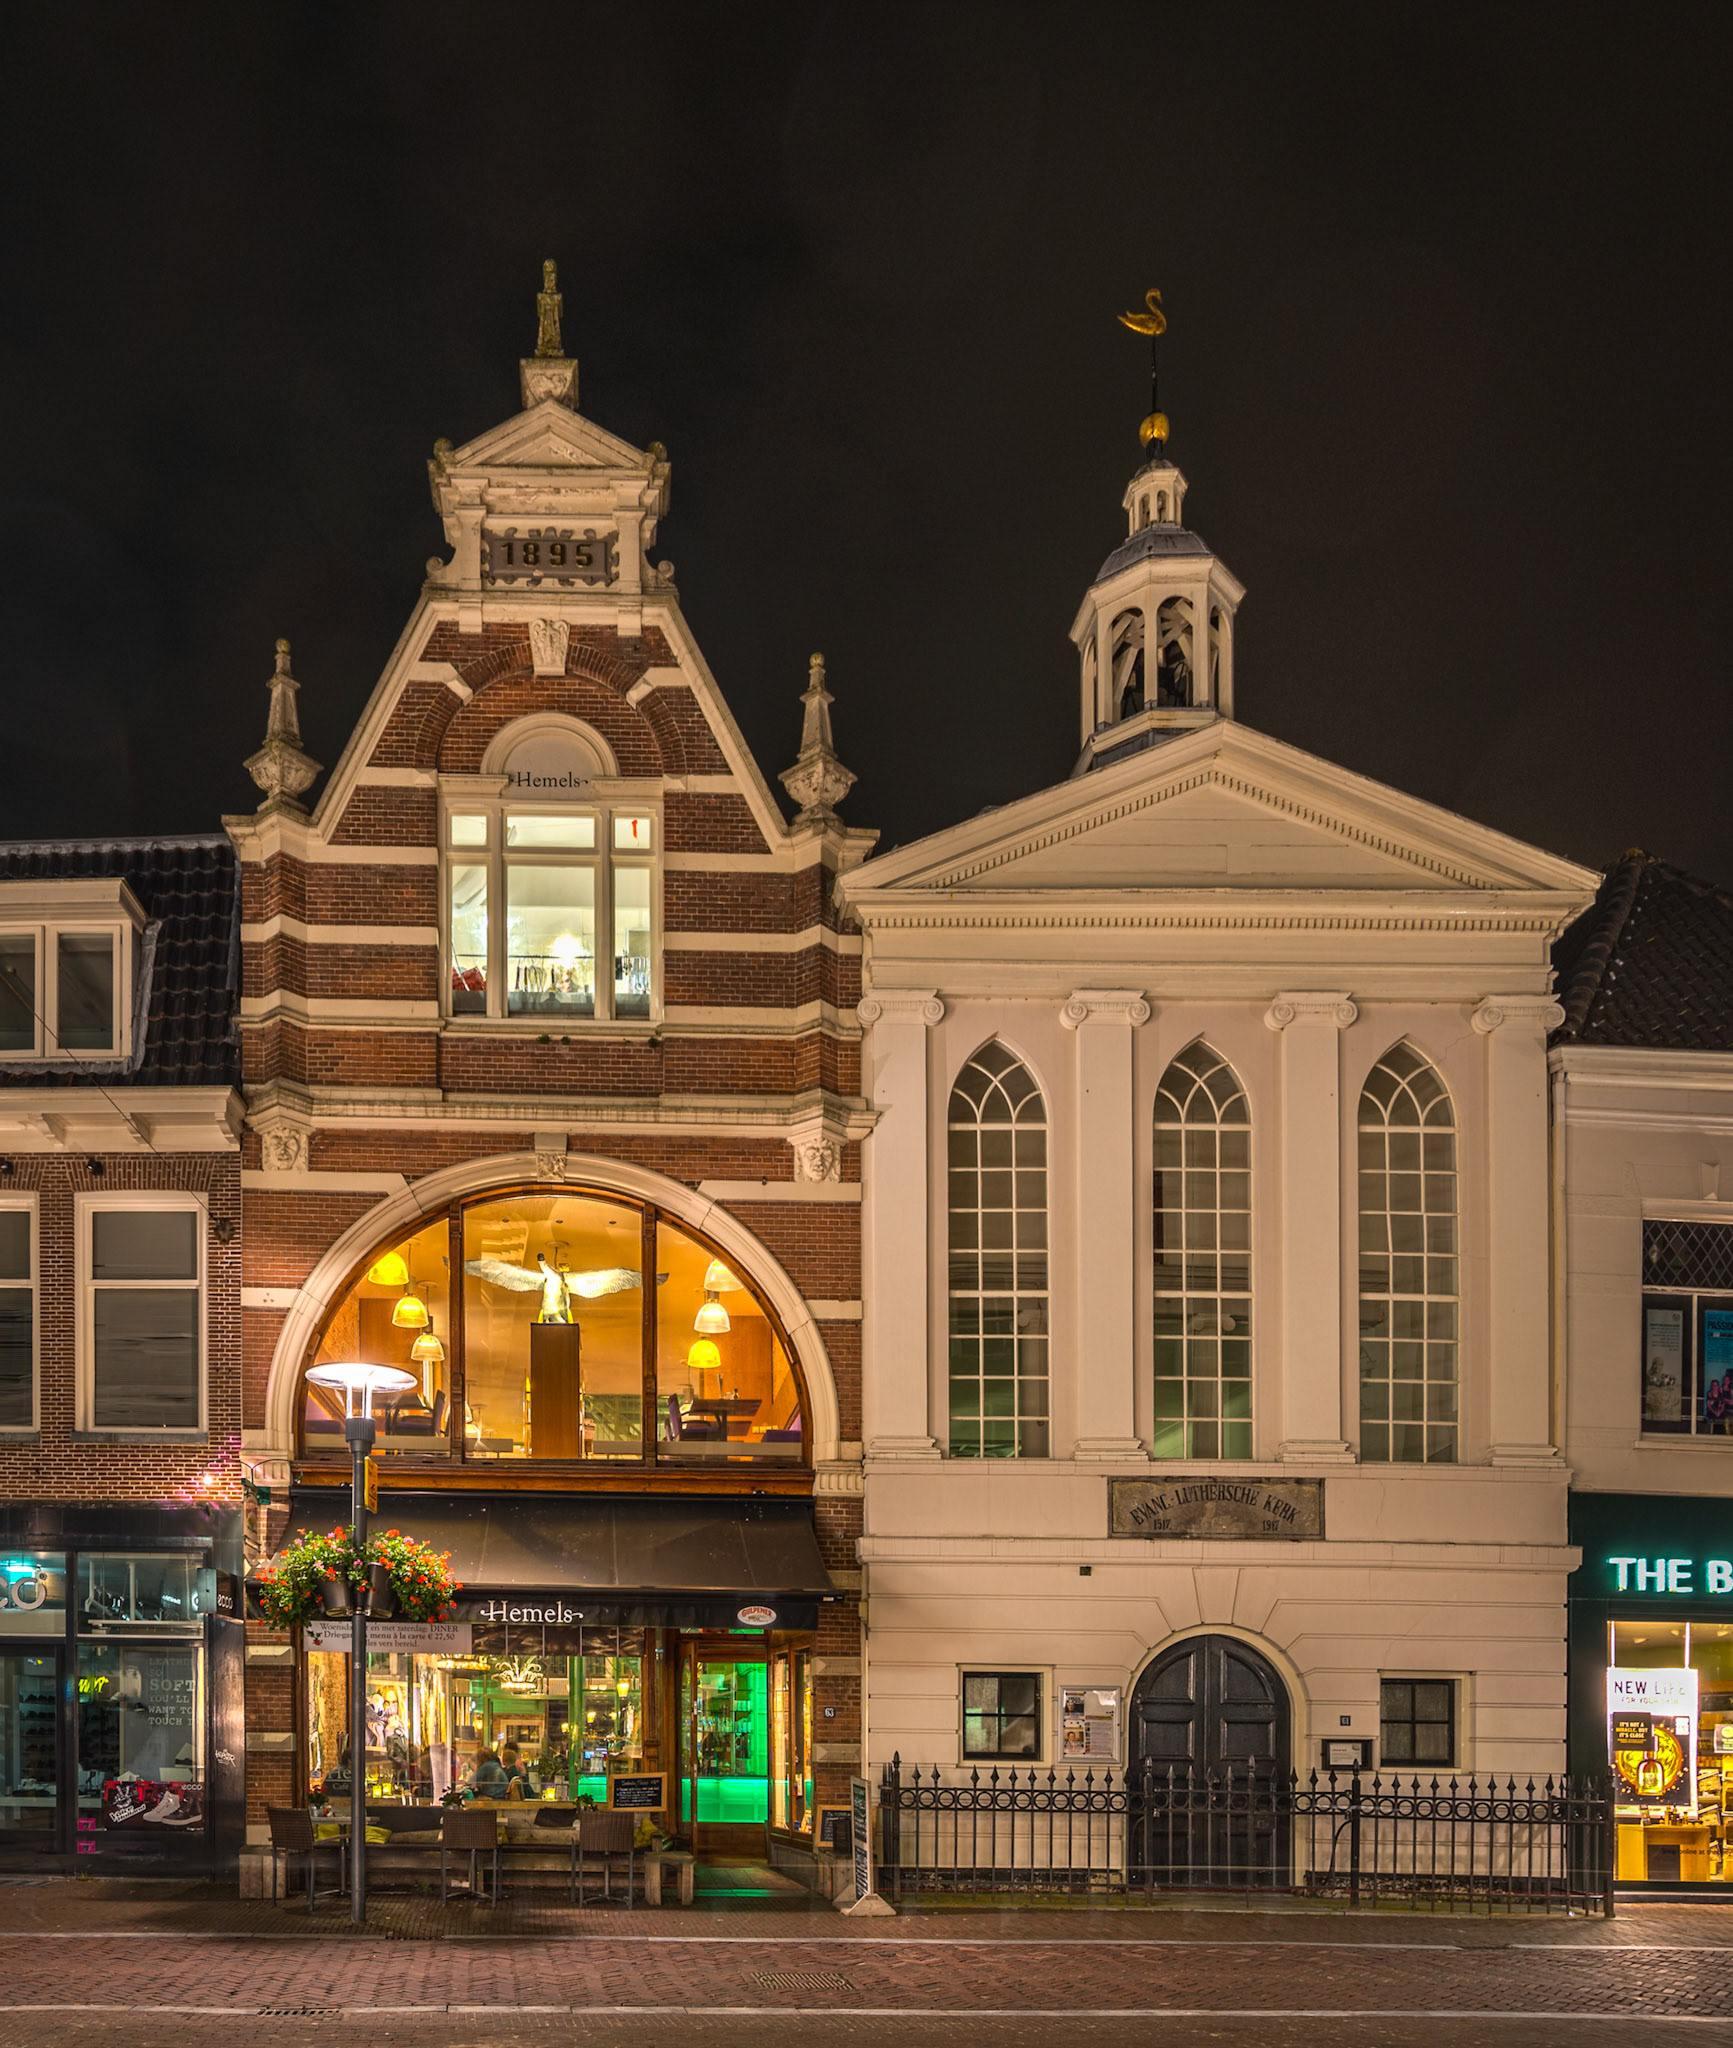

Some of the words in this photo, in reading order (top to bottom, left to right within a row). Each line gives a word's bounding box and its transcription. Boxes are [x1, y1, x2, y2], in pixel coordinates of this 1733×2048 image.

[501, 542, 592, 568] 1895
[511, 771, 588, 788] Hemels
[1608, 1557, 1693, 1593] THE
[1707, 1559, 1733, 1593] B
[480, 1600, 584, 1623] Hemels
[430, 1625, 459, 1633] DINER
[435, 1633, 455, 1641] 27,50
[150, 1680, 196, 1692] SOFT
[1614, 1680, 1647, 1695] NEW
[149, 1695, 190, 1703] YOU'LL
[148, 1706, 176, 1714] WANT
[825, 1707, 835, 1718] 63
[148, 1717, 183, 1726] TOUCH
[181, 1783, 203, 1791] ecco
